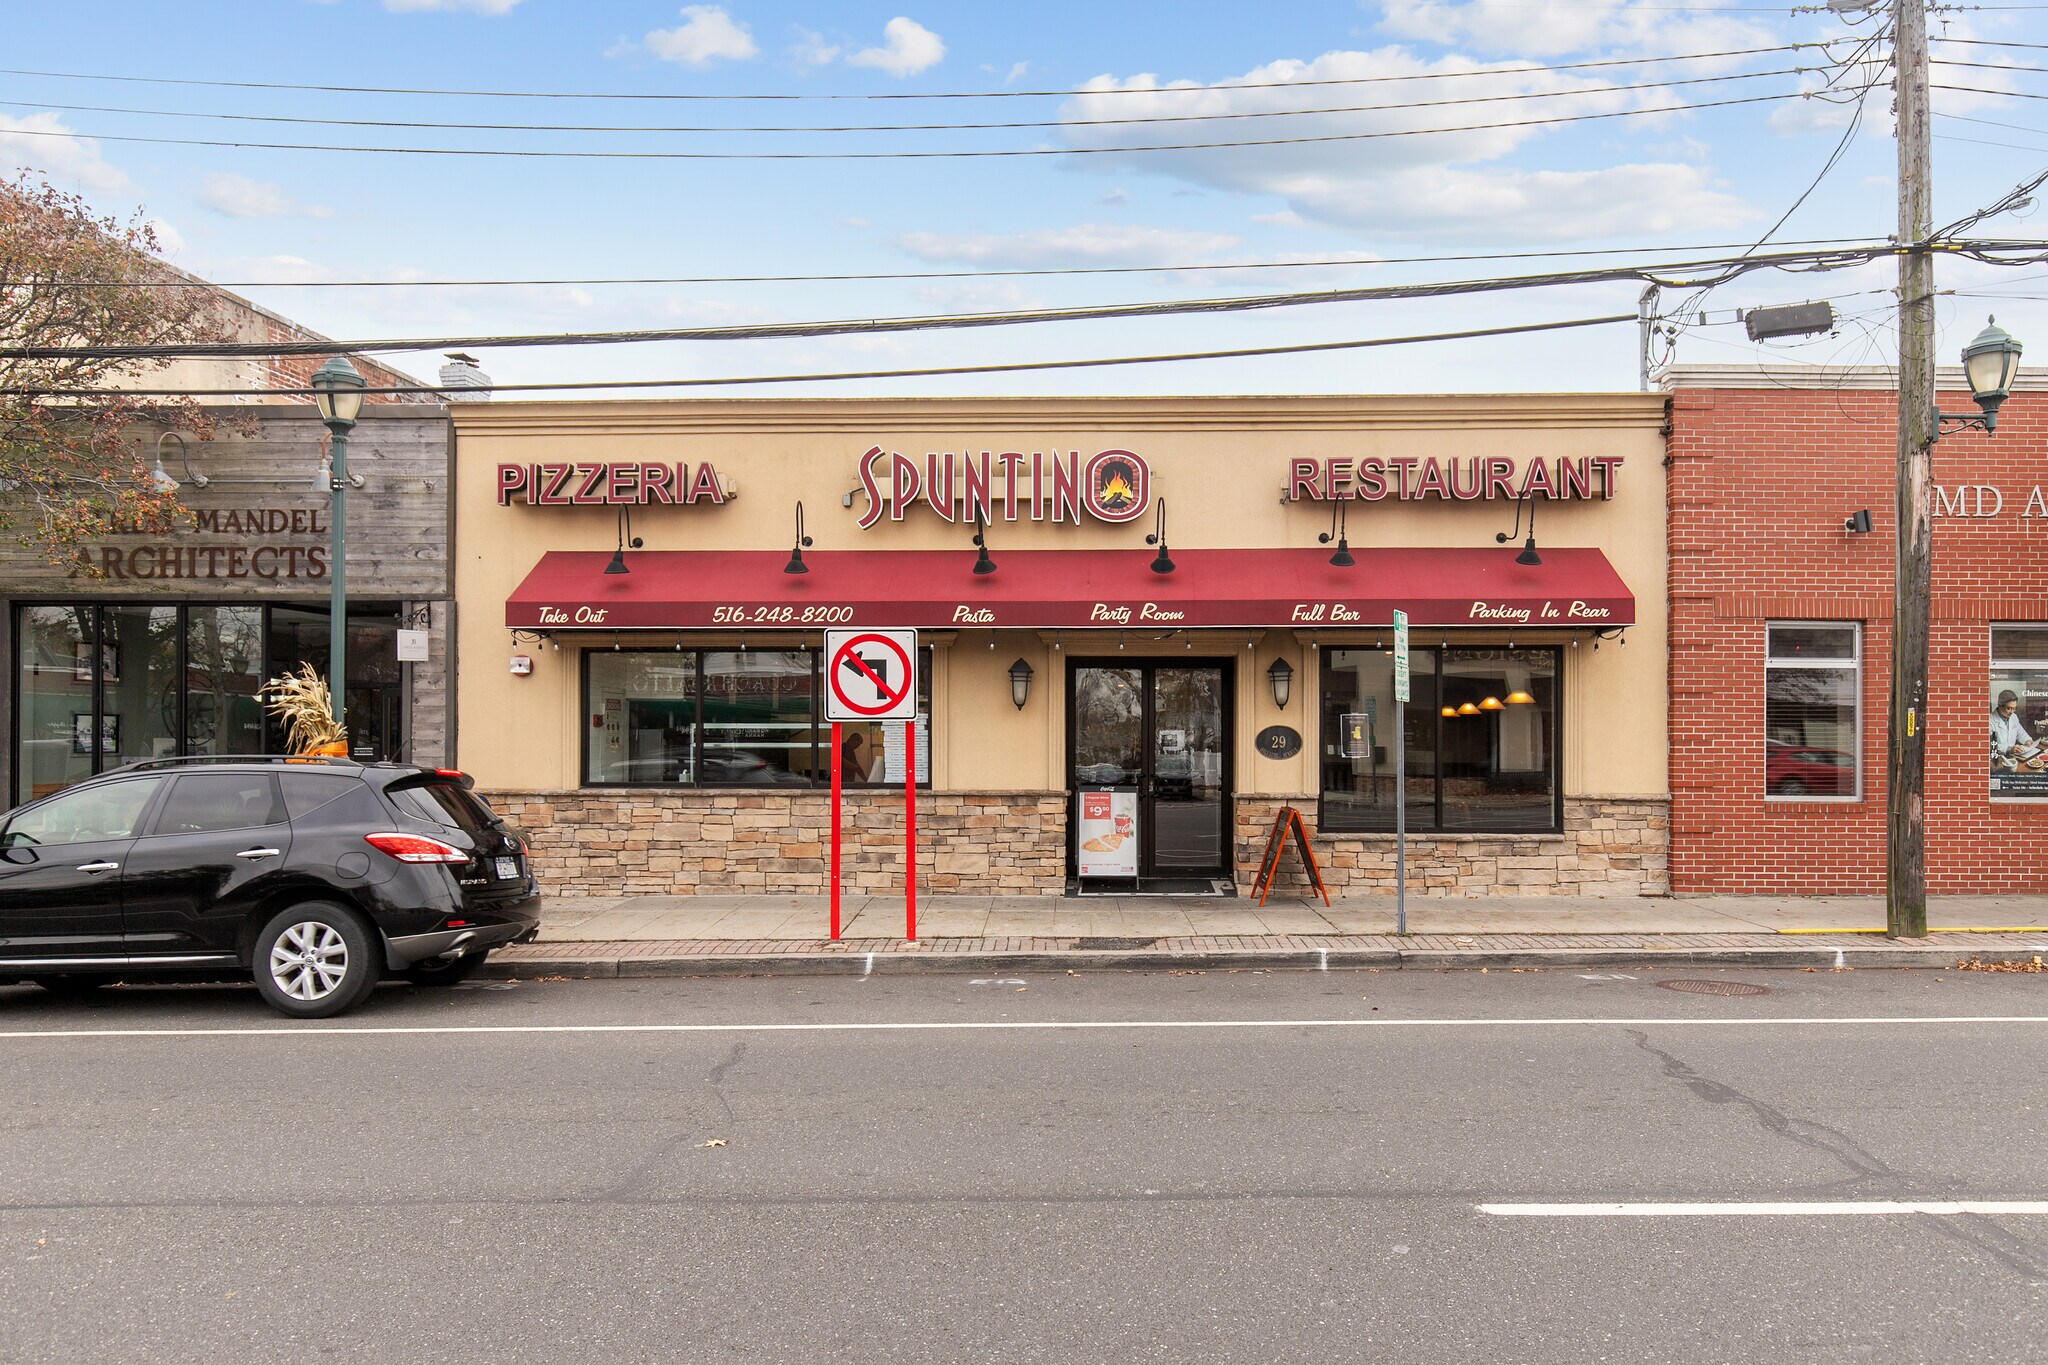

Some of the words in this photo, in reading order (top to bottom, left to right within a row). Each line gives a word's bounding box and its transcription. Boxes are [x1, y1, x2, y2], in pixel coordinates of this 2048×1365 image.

[497, 462, 725, 506] PIZZERIA
[856, 444, 1151, 531] SPUNTINO
[1289, 456, 1625, 501] RESTAURANT
[1932, 485, 2003, 517] MD
[194, 509, 327, 534] MANDEL
[538, 606, 569, 624] Take
[574, 605, 609, 624] Out
[711, 605, 854, 624] 516-248-8200
[952, 605, 996, 624] Pasta
[1090, 602, 1132, 625] Party
[1139, 602, 1185, 621] Room
[1291, 604, 1324, 622] Full
[1330, 604, 1361, 622] Bar
[1469, 602, 1531, 623] Parking
[1540, 601, 1560, 619] In
[1567, 600, 1611, 619] Rear
[1271, 735, 1287, 749] 29
